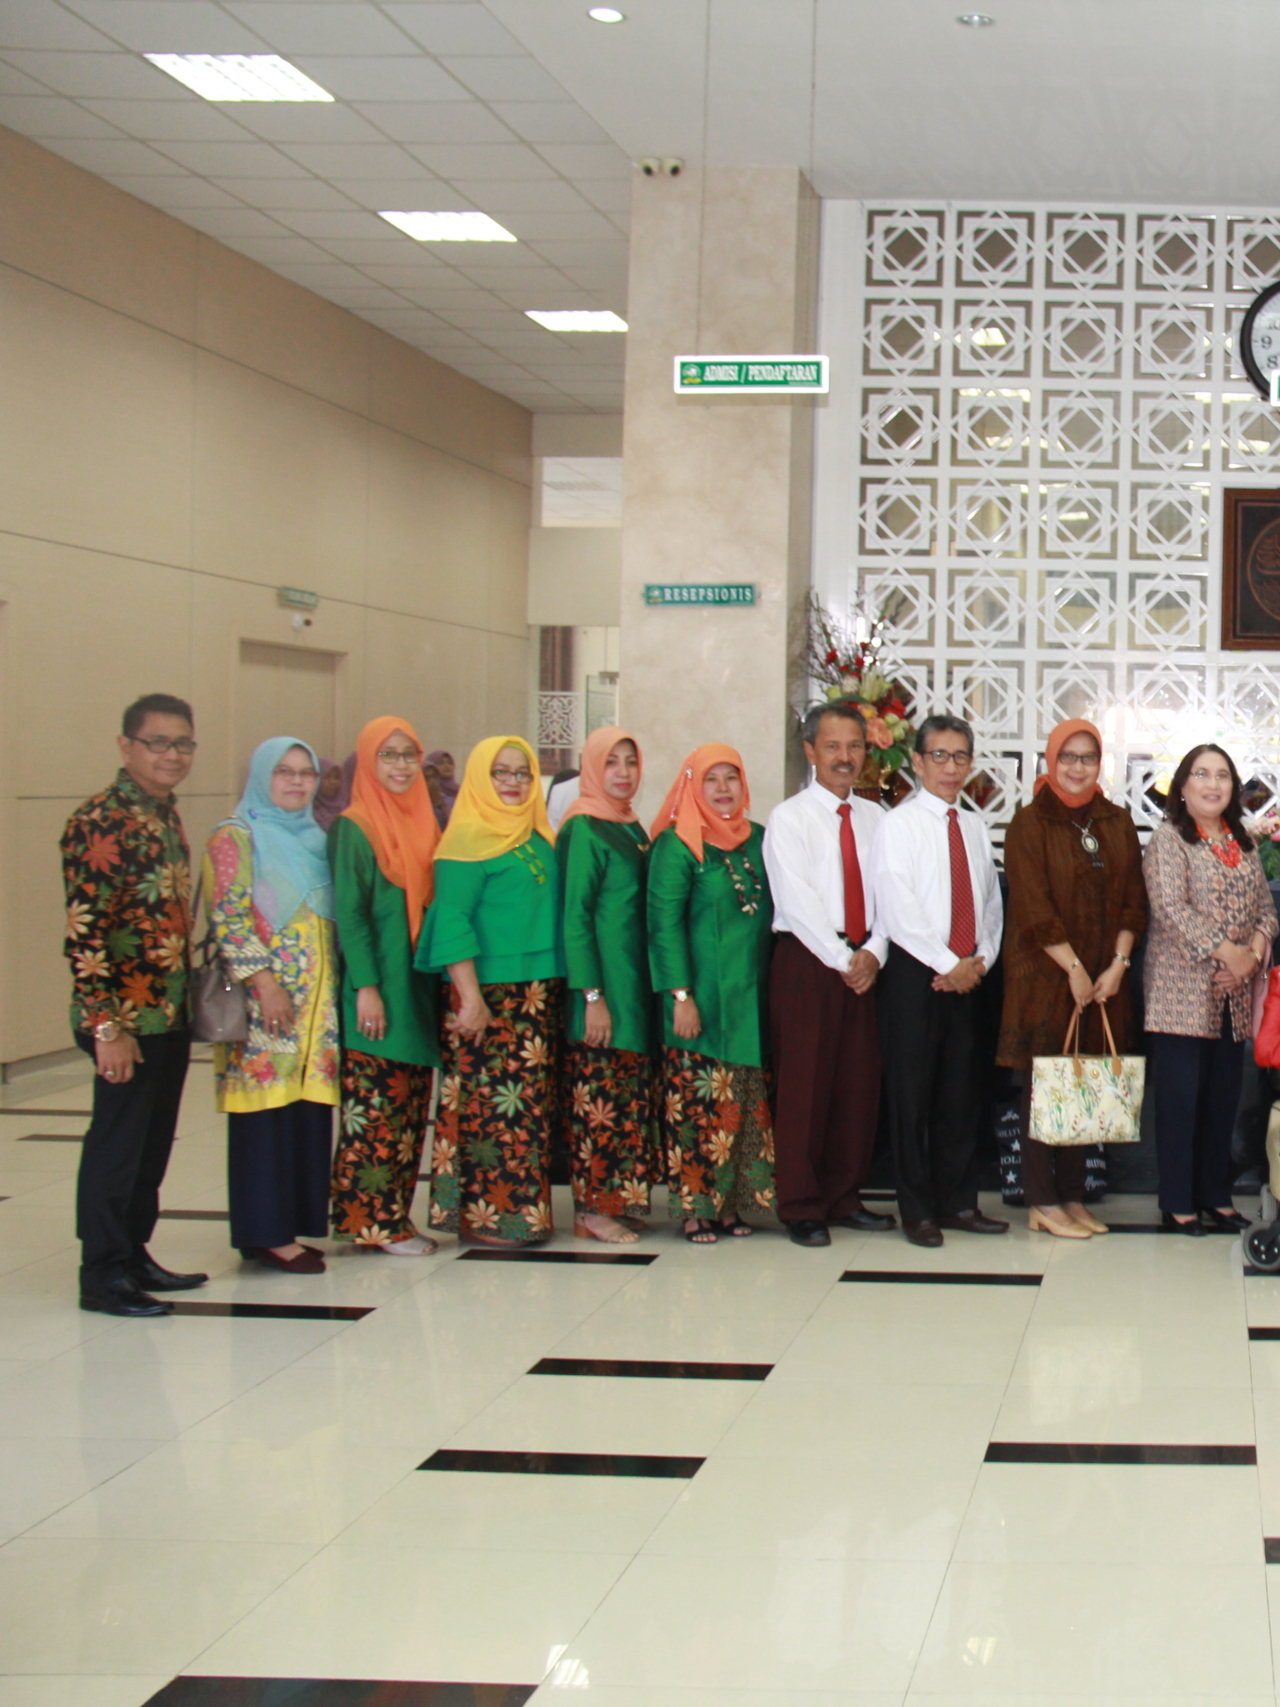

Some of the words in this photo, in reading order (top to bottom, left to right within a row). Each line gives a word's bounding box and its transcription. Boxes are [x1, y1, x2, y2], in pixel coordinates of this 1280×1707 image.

[1261, 335, 1272, 350] 9
[1266, 355, 1278, 369] 8
[703, 365, 739, 381] ADMISI
[748, 364, 818, 381] PENDAFTARAN
[663, 587, 752, 601] RESEPSIONIS
